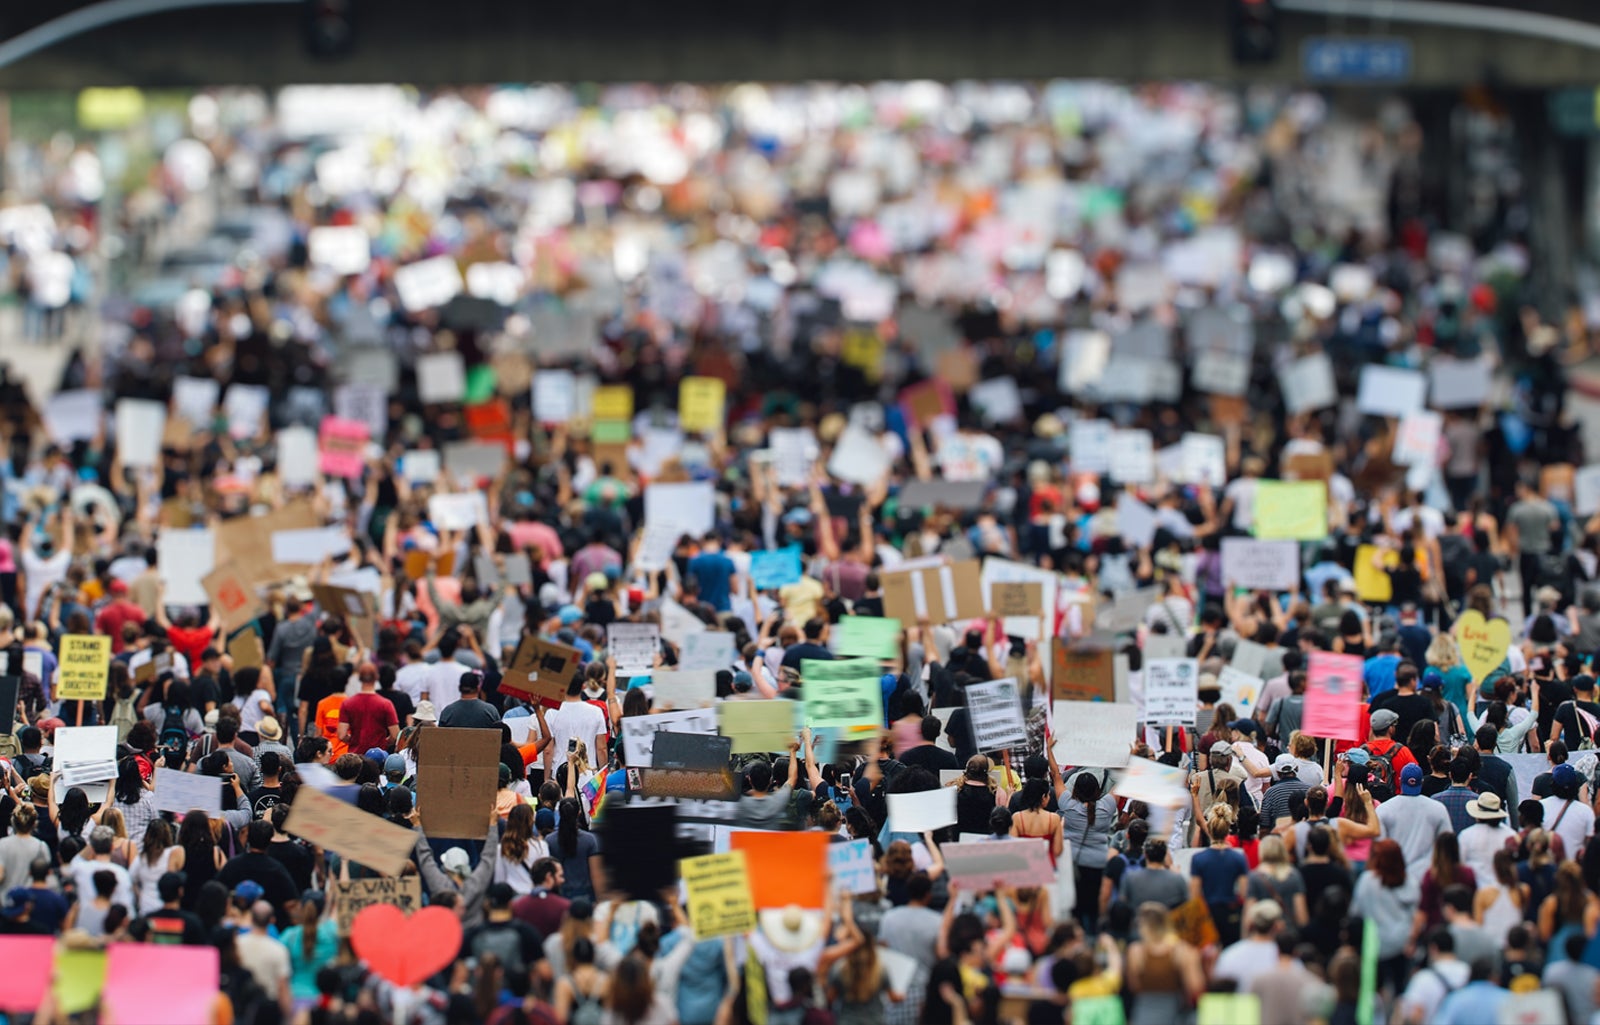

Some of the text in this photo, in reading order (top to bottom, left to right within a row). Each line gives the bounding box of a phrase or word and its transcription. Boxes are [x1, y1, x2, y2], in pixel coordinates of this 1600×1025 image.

[70, 640, 101, 650] STAND
[978, 727, 1023, 742] WORKERS
[338, 879, 411, 896] WE WANT
